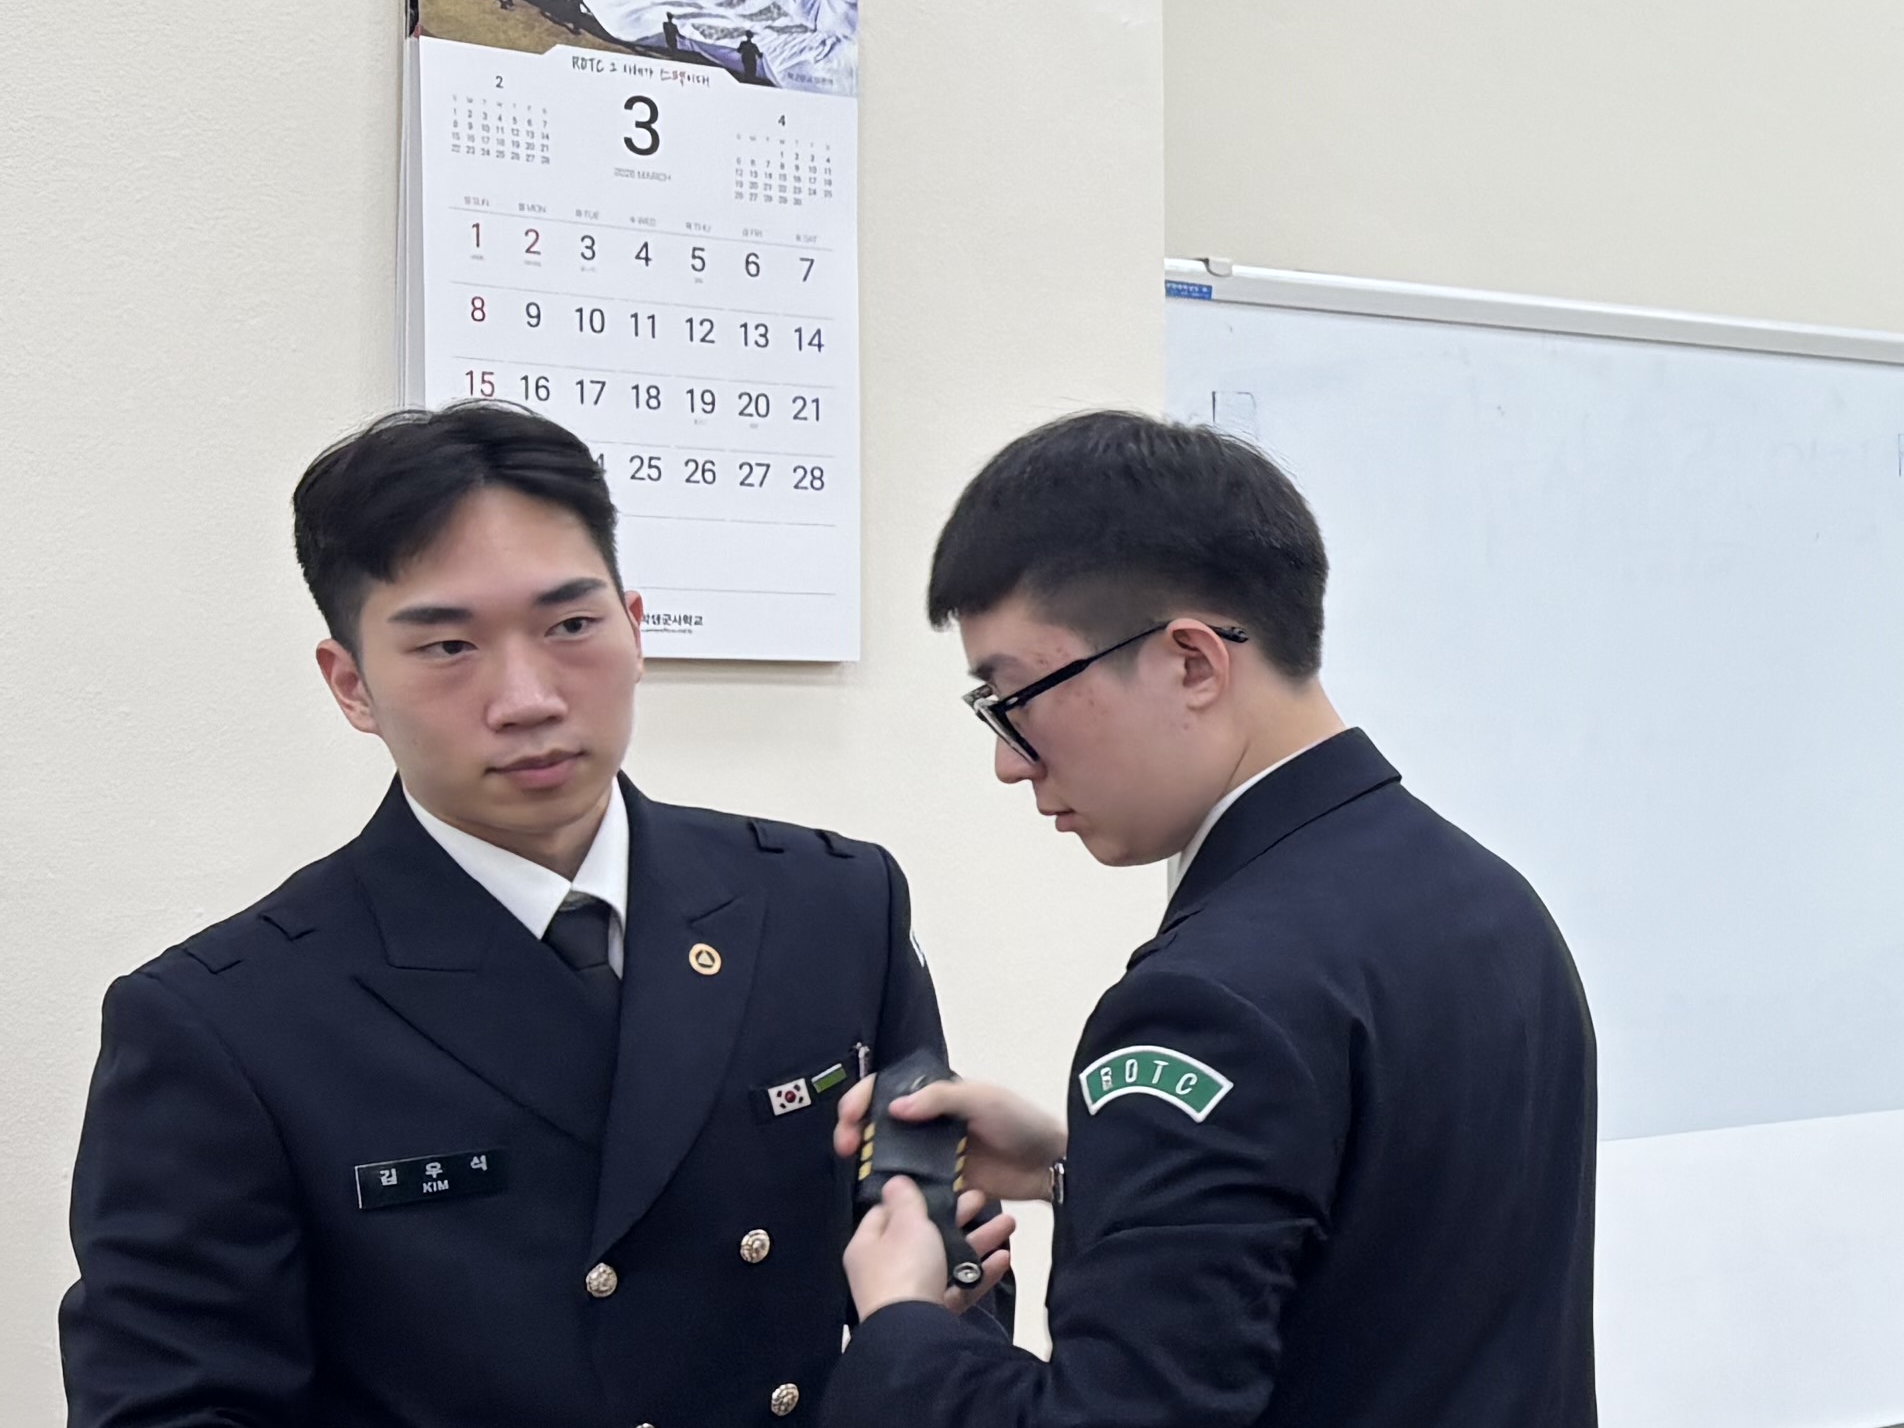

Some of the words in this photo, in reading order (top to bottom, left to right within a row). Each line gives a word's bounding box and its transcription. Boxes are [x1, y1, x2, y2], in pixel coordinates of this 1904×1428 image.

[495, 75, 504, 89] 2
[572, 56, 604, 73] ROTC
[624, 94, 661, 157] 3
[778, 114, 786, 127] 4
[471, 222, 481, 249] 1
[524, 228, 542, 256] 2
[580, 234, 596, 261] 3
[634, 240, 653, 268] 4
[690, 246, 706, 273] 5
[744, 251, 761, 278] 6
[799, 257, 815, 283] 7
[470, 295, 487, 323] 8
[525, 301, 542, 329] 9
[574, 306, 606, 334] 10
[629, 311, 656, 339] 11
[685, 316, 716, 345] 12
[739, 321, 770, 349] 13
[794, 326, 825, 353] 14
[465, 369, 496, 398] 15
[520, 374, 551, 402] 16
[575, 378, 607, 406] 17
[631, 383, 662, 411] 18
[685, 387, 716, 415] 19
[737, 391, 771, 419] 20
[791, 395, 820, 422] 21
[629, 454, 662, 482] 25
[684, 458, 717, 485] 26
[738, 461, 771, 488] 27
[792, 464, 825, 492] 28
[1100, 1058, 1198, 1095] ROTC
[422, 1180, 449, 1194] KIM
